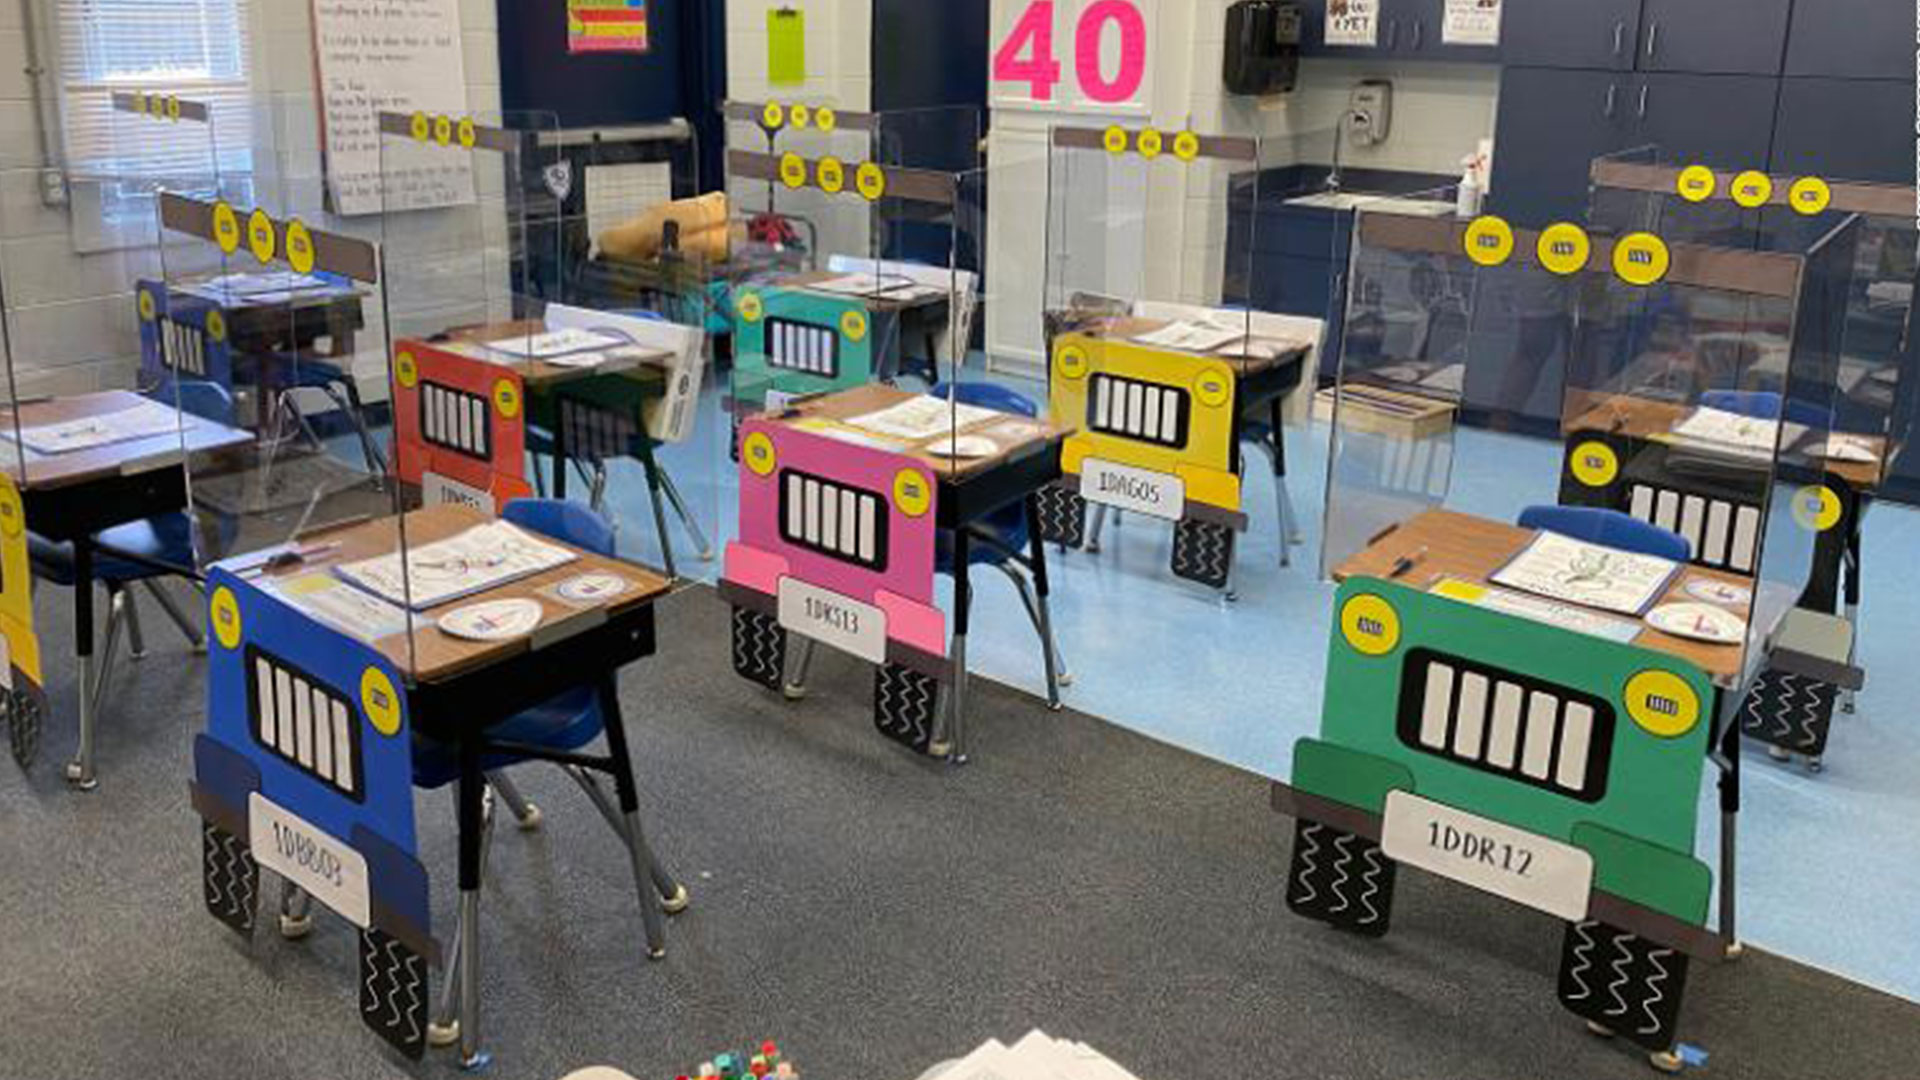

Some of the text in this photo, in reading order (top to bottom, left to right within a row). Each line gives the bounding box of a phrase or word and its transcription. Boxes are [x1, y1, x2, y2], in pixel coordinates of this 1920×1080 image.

[994, 0, 1146, 103] 40
[804, 596, 859, 635] 1DKS13
[1428, 821, 1534, 879] 1DDR12
